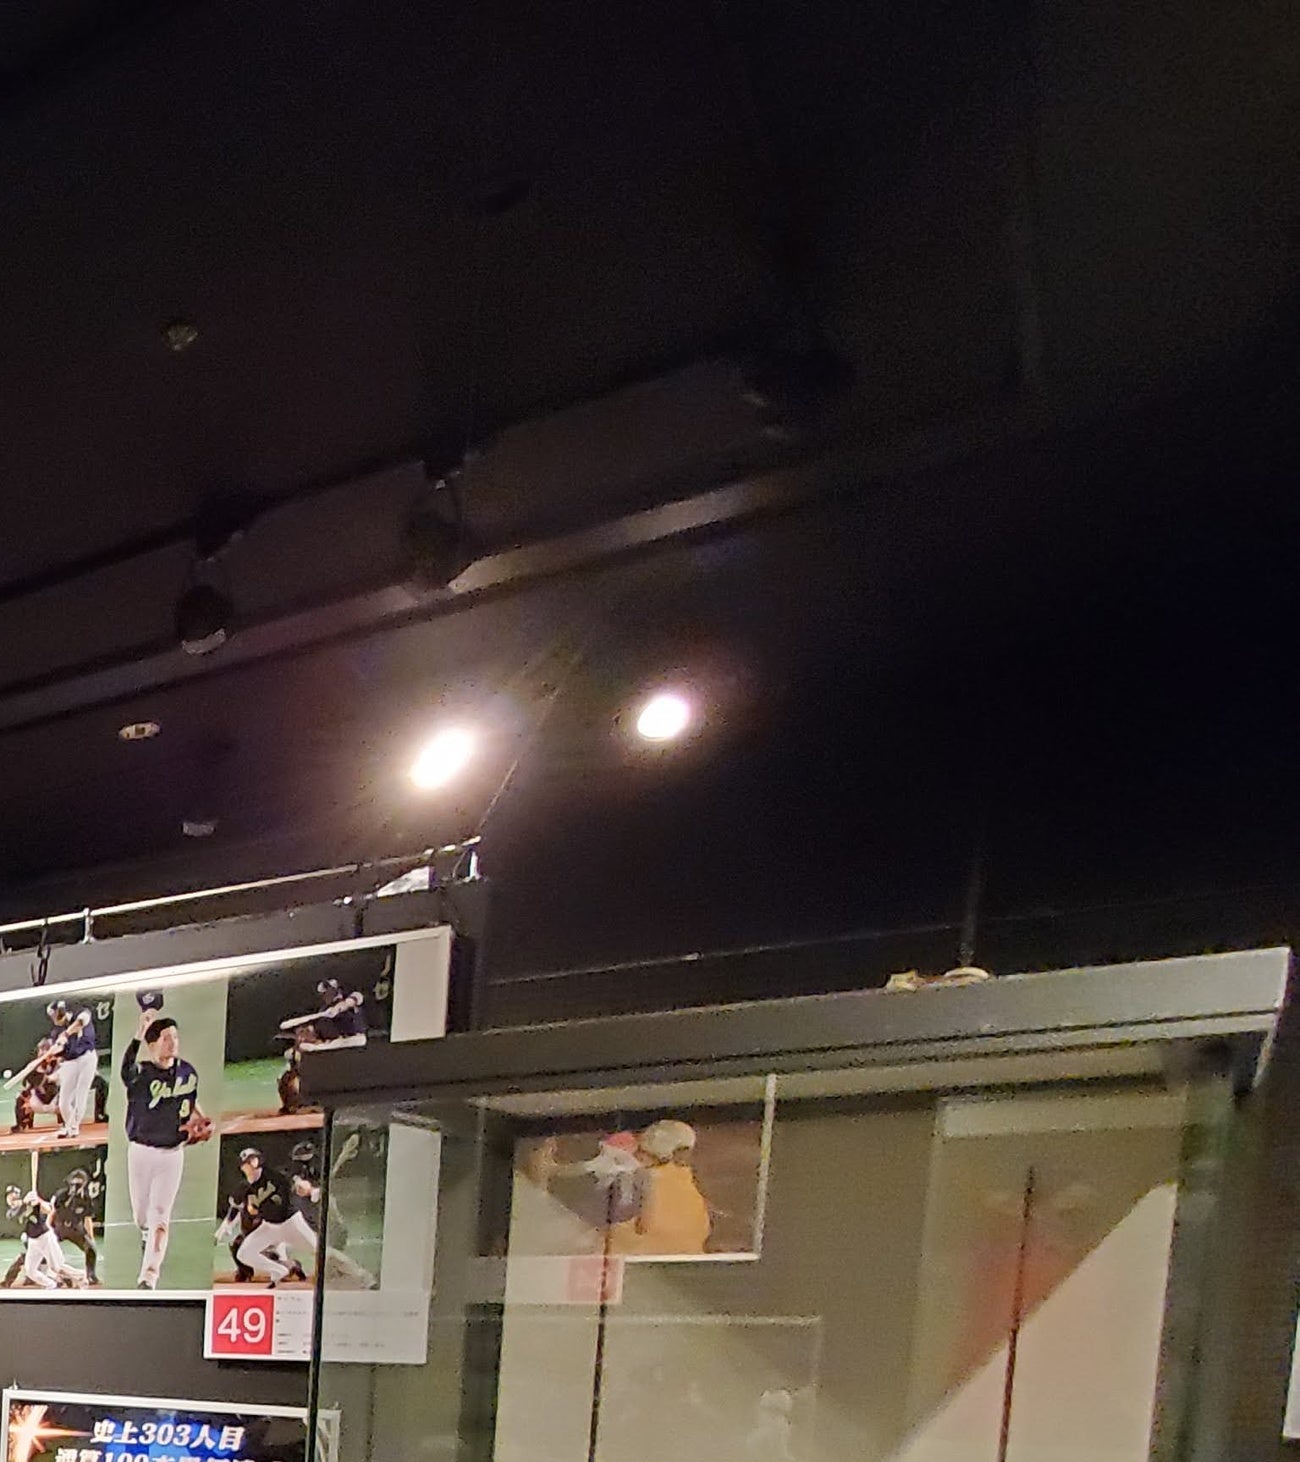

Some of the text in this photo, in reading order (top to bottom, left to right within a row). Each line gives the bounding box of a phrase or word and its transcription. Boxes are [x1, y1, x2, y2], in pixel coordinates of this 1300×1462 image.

[216, 1306, 267, 1345] 49
[90, 1419, 246, 1451] 史上303人目
